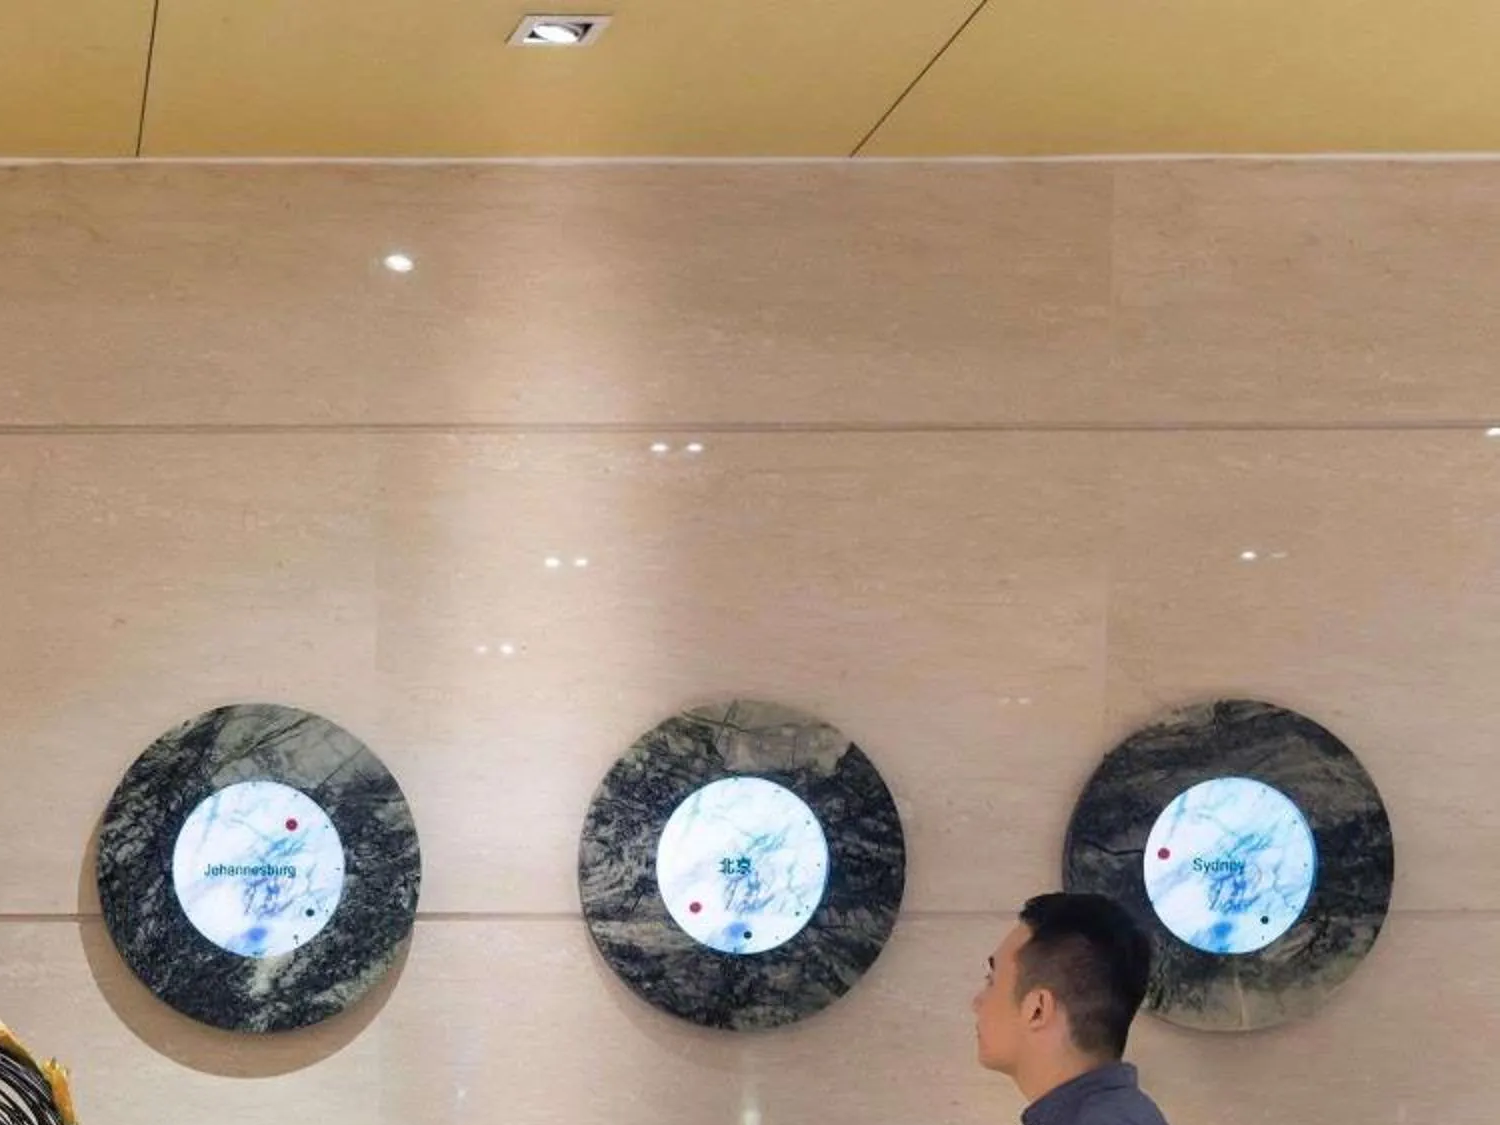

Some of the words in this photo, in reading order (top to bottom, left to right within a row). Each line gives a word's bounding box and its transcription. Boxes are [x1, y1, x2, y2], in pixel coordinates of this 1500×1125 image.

[203, 863, 297, 879] Johannesburg
[719, 856, 752, 875] 北京
[1192, 857, 1244, 875] Sydney
